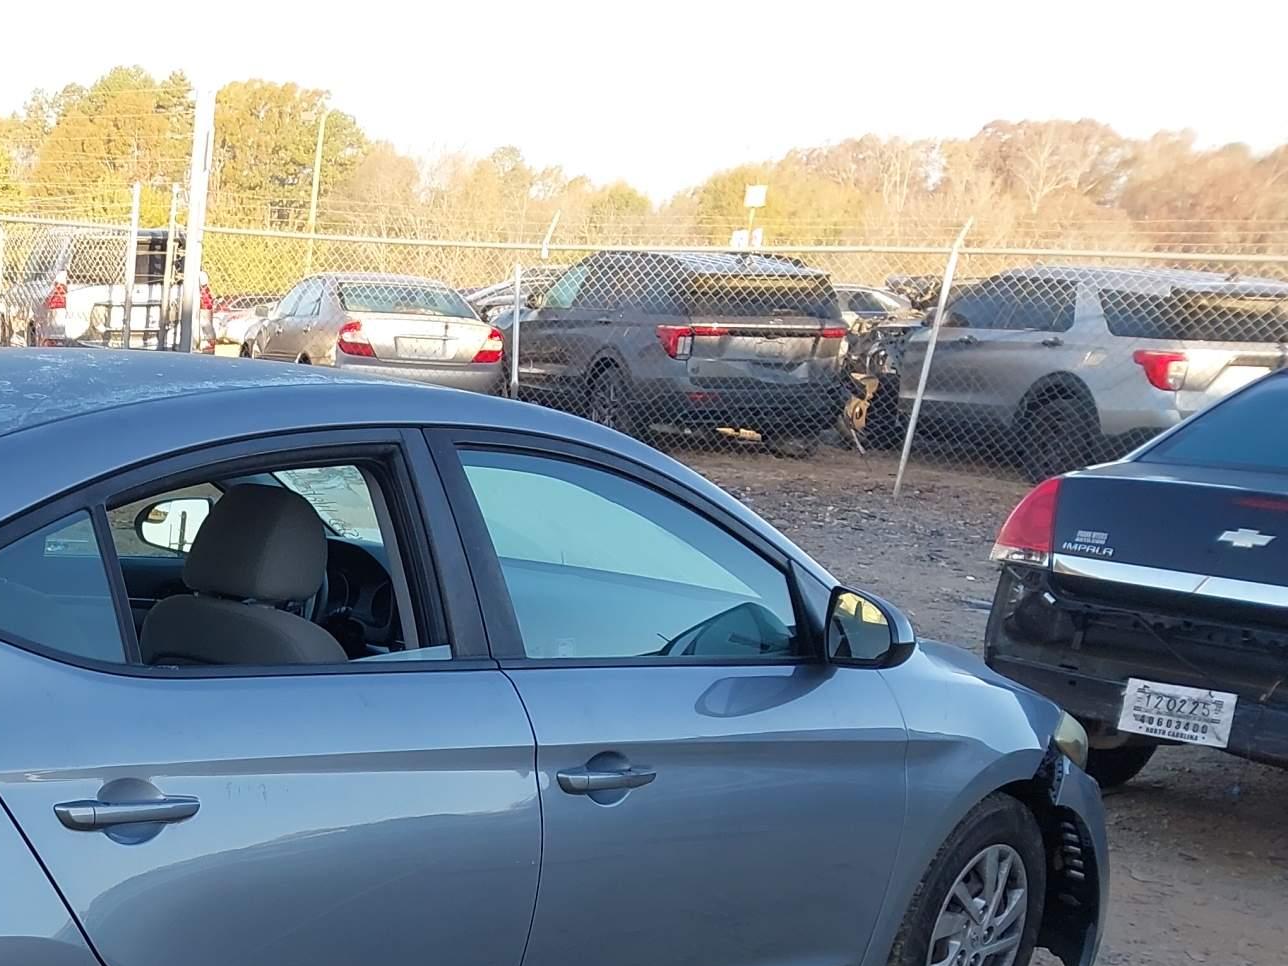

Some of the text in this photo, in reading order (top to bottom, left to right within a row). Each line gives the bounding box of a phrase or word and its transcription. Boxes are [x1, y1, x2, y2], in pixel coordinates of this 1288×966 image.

[1062, 541, 1114, 557] IMPALA
[1145, 727, 1200, 741] NORTH CAROLINA
